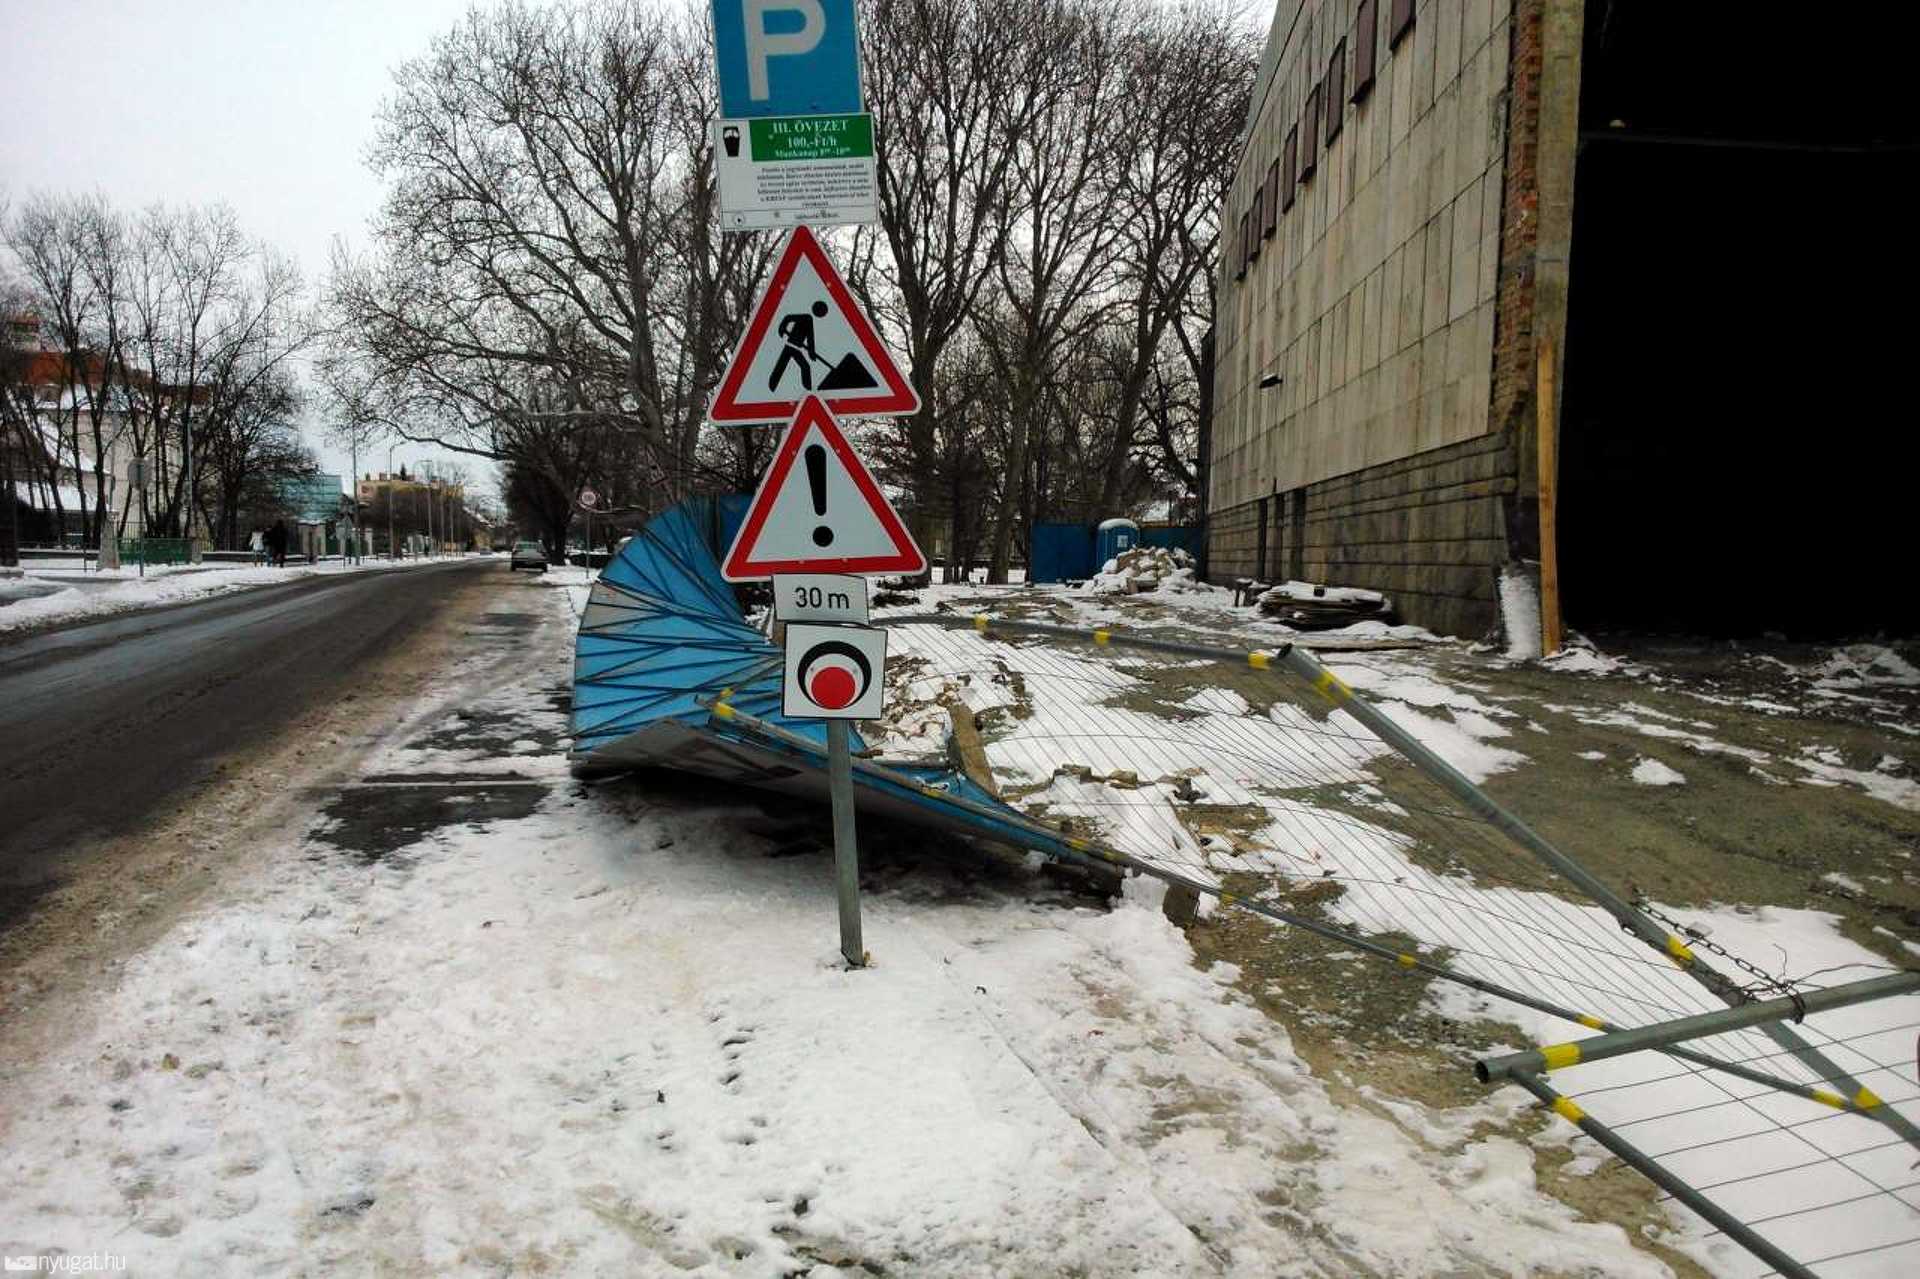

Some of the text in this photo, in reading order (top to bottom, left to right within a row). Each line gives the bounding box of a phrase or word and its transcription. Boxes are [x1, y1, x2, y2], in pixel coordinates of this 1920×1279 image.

[742, 0, 826, 101] P
[773, 119, 849, 134] III. ÖVEZET
[794, 587, 850, 609] 30 m
